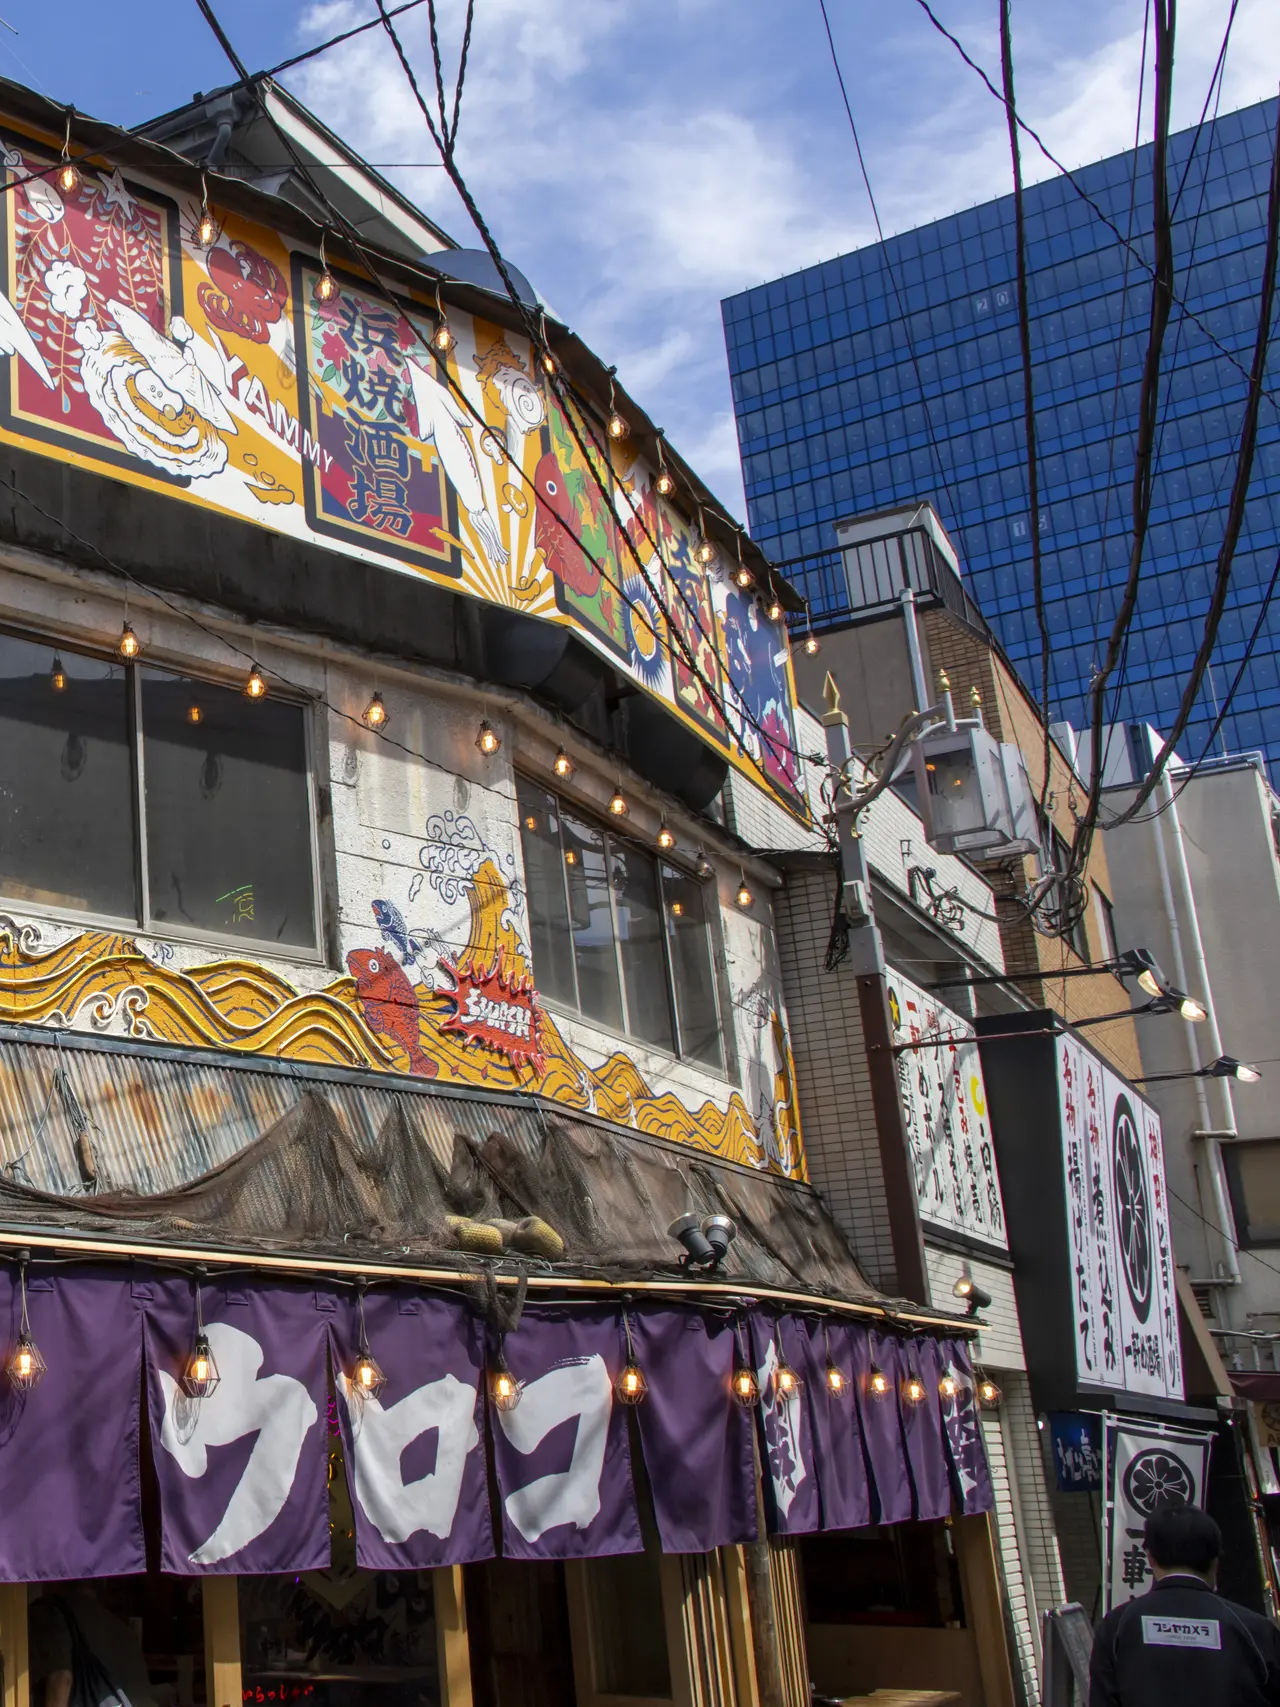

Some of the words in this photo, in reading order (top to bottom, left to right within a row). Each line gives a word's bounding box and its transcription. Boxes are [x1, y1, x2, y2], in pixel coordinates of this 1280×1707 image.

[205, 322, 336, 474] YAMMY
[338, 295, 414, 537] 浜焼酒場
[159, 1322, 613, 1564] ウロコ
[1153, 1622, 1210, 1636] フジヤカメラ
